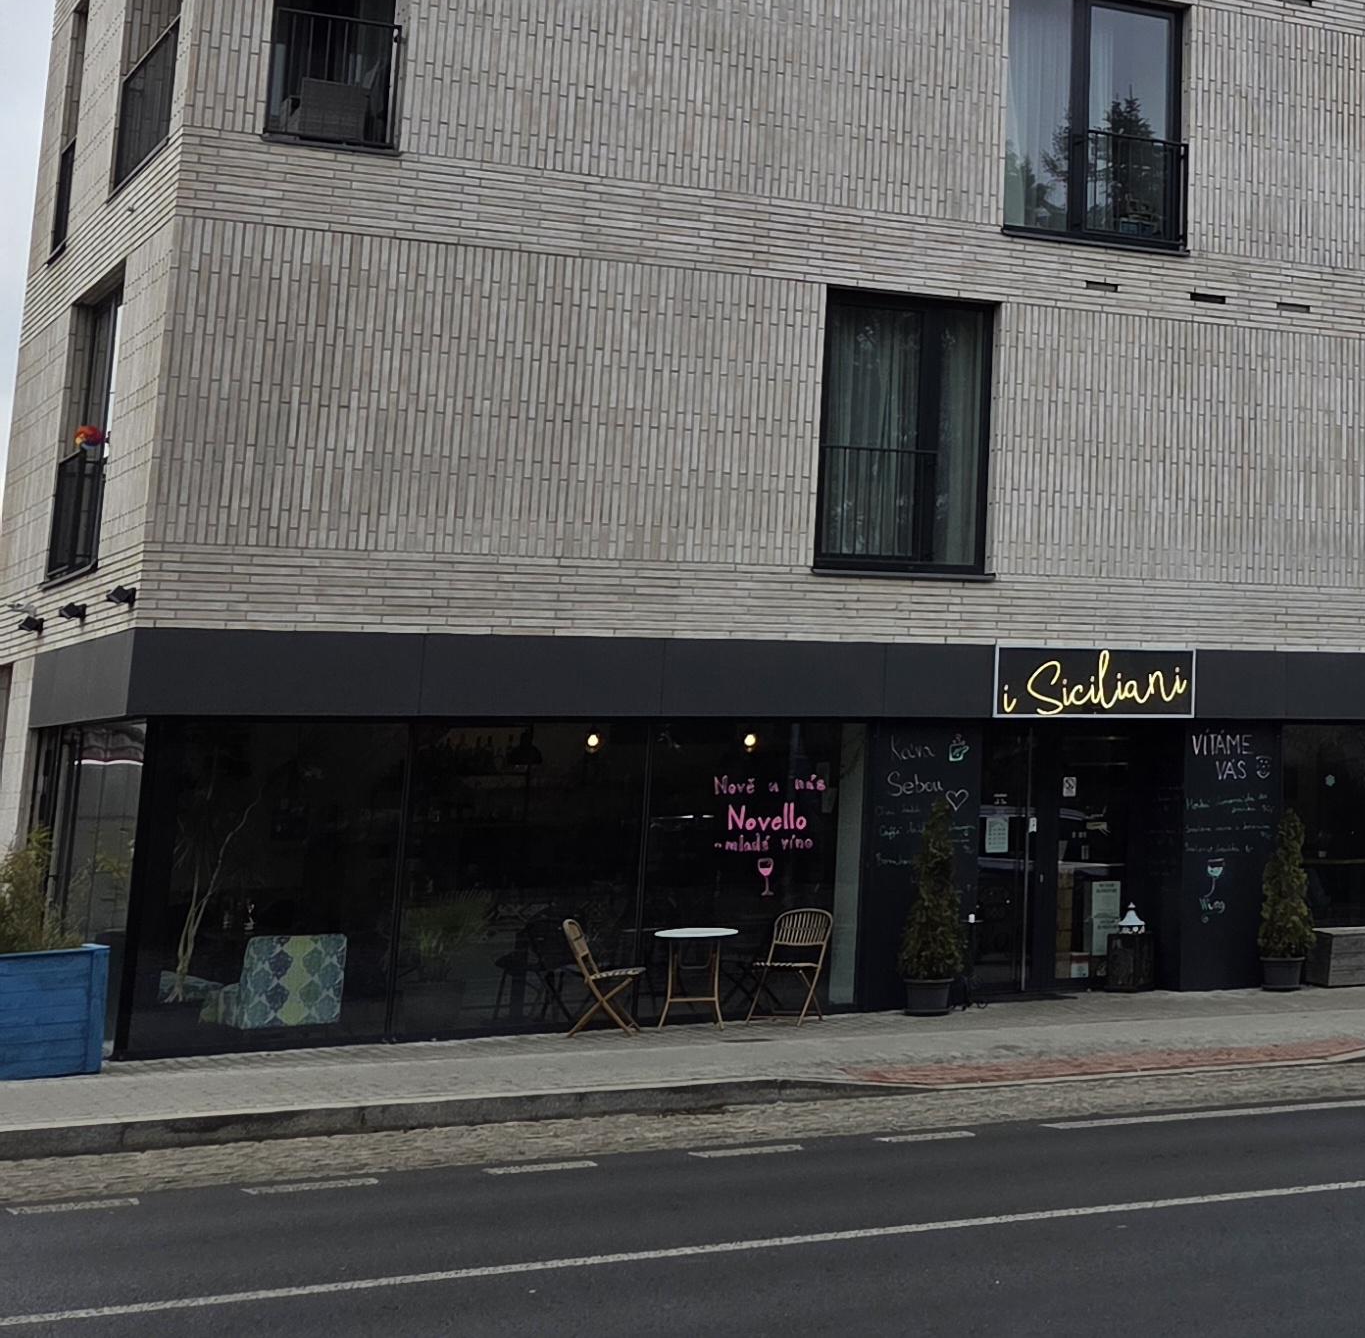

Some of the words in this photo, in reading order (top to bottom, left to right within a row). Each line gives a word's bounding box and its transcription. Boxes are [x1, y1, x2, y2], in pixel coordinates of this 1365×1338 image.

[1003, 683, 1018, 713] i
[1026, 649, 1188, 716] Siciliani
[1191, 727, 1254, 756] VÍTÁME
[1215, 758, 1248, 781] VÁS
[713, 774, 756, 796] Nově
[767, 781, 780, 793] u
[794, 773, 827, 791] nás
[887, 770, 944, 798] Sebou
[727, 801, 808, 832] Novello
[780, 833, 814, 851] víno
